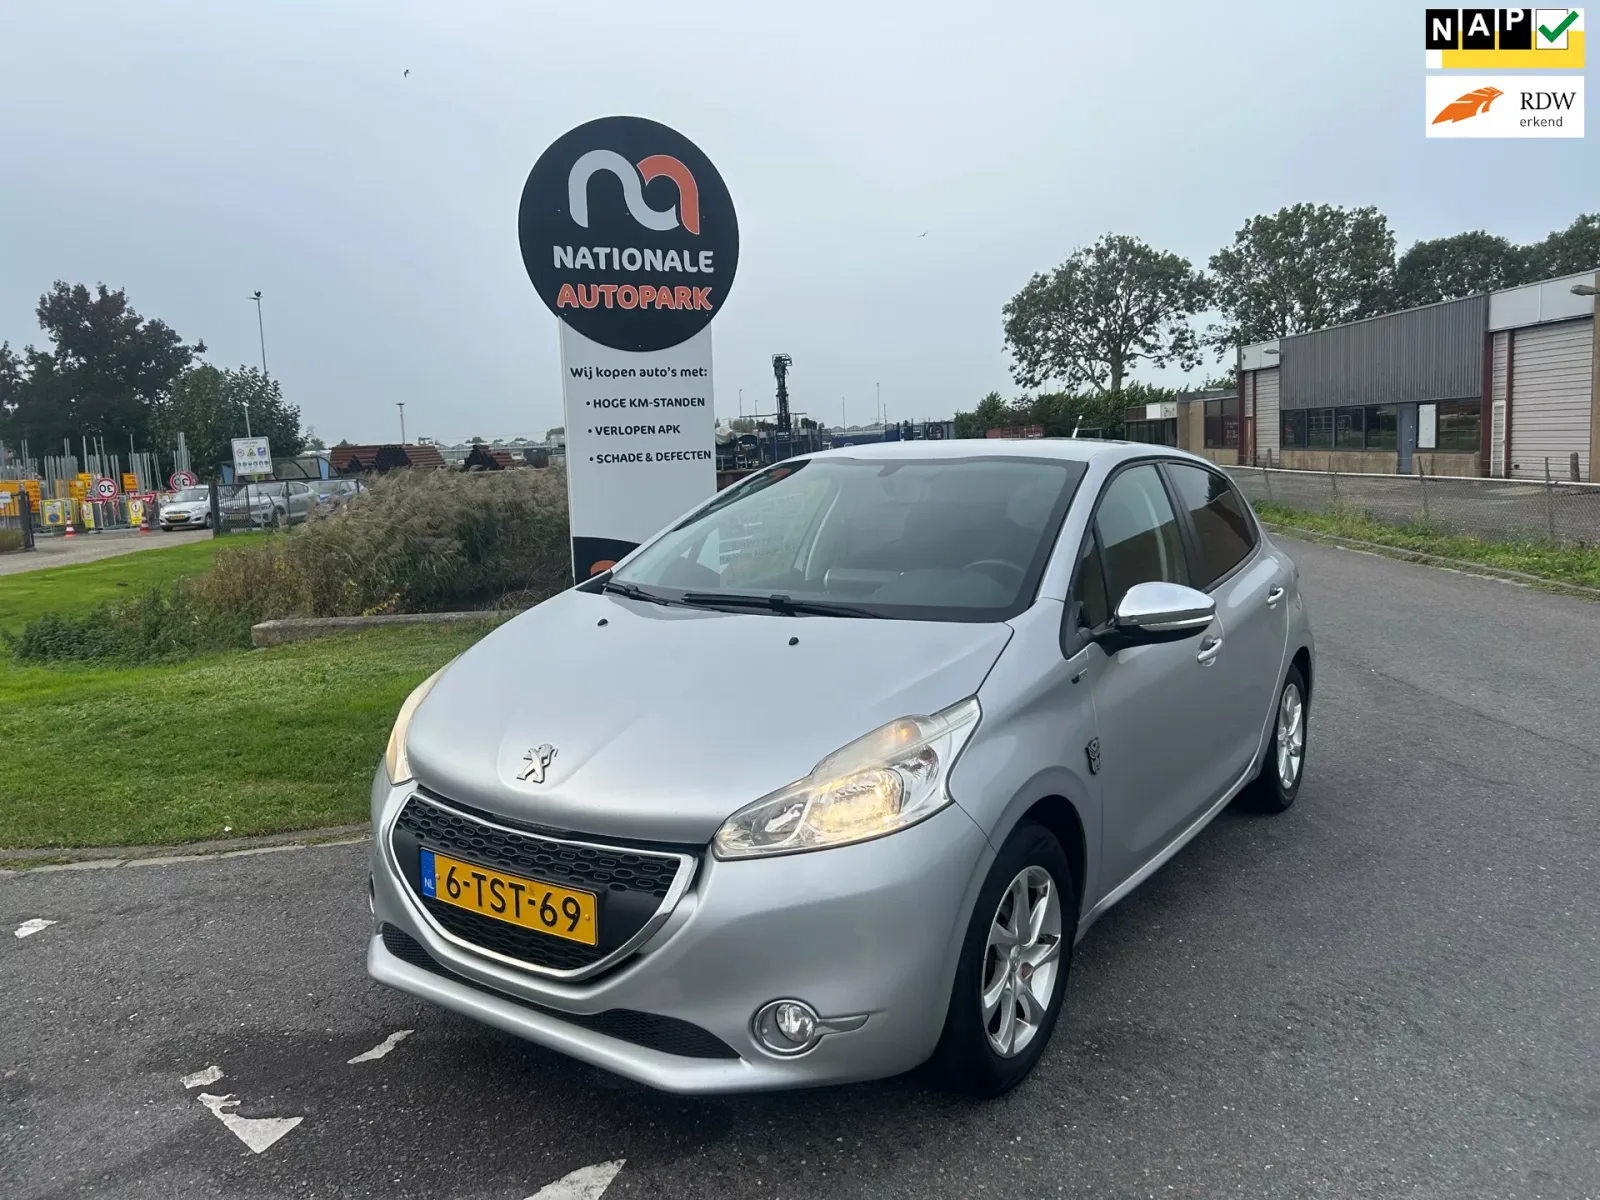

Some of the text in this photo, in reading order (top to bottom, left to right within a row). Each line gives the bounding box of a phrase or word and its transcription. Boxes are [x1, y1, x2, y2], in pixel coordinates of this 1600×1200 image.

[553, 245, 715, 273] NATIONALE
[556, 283, 713, 310] AUTOPARK
[570, 367, 708, 380] Wij kopen auto's met:
[593, 397, 706, 408] HOGE KM-STANDEN
[595, 424, 681, 436] VERLOPEN APK
[596, 450, 712, 464] SCHADE & DEFECTEN
[424, 878, 435, 890] NL
[446, 865, 581, 933] 6-TST-69
